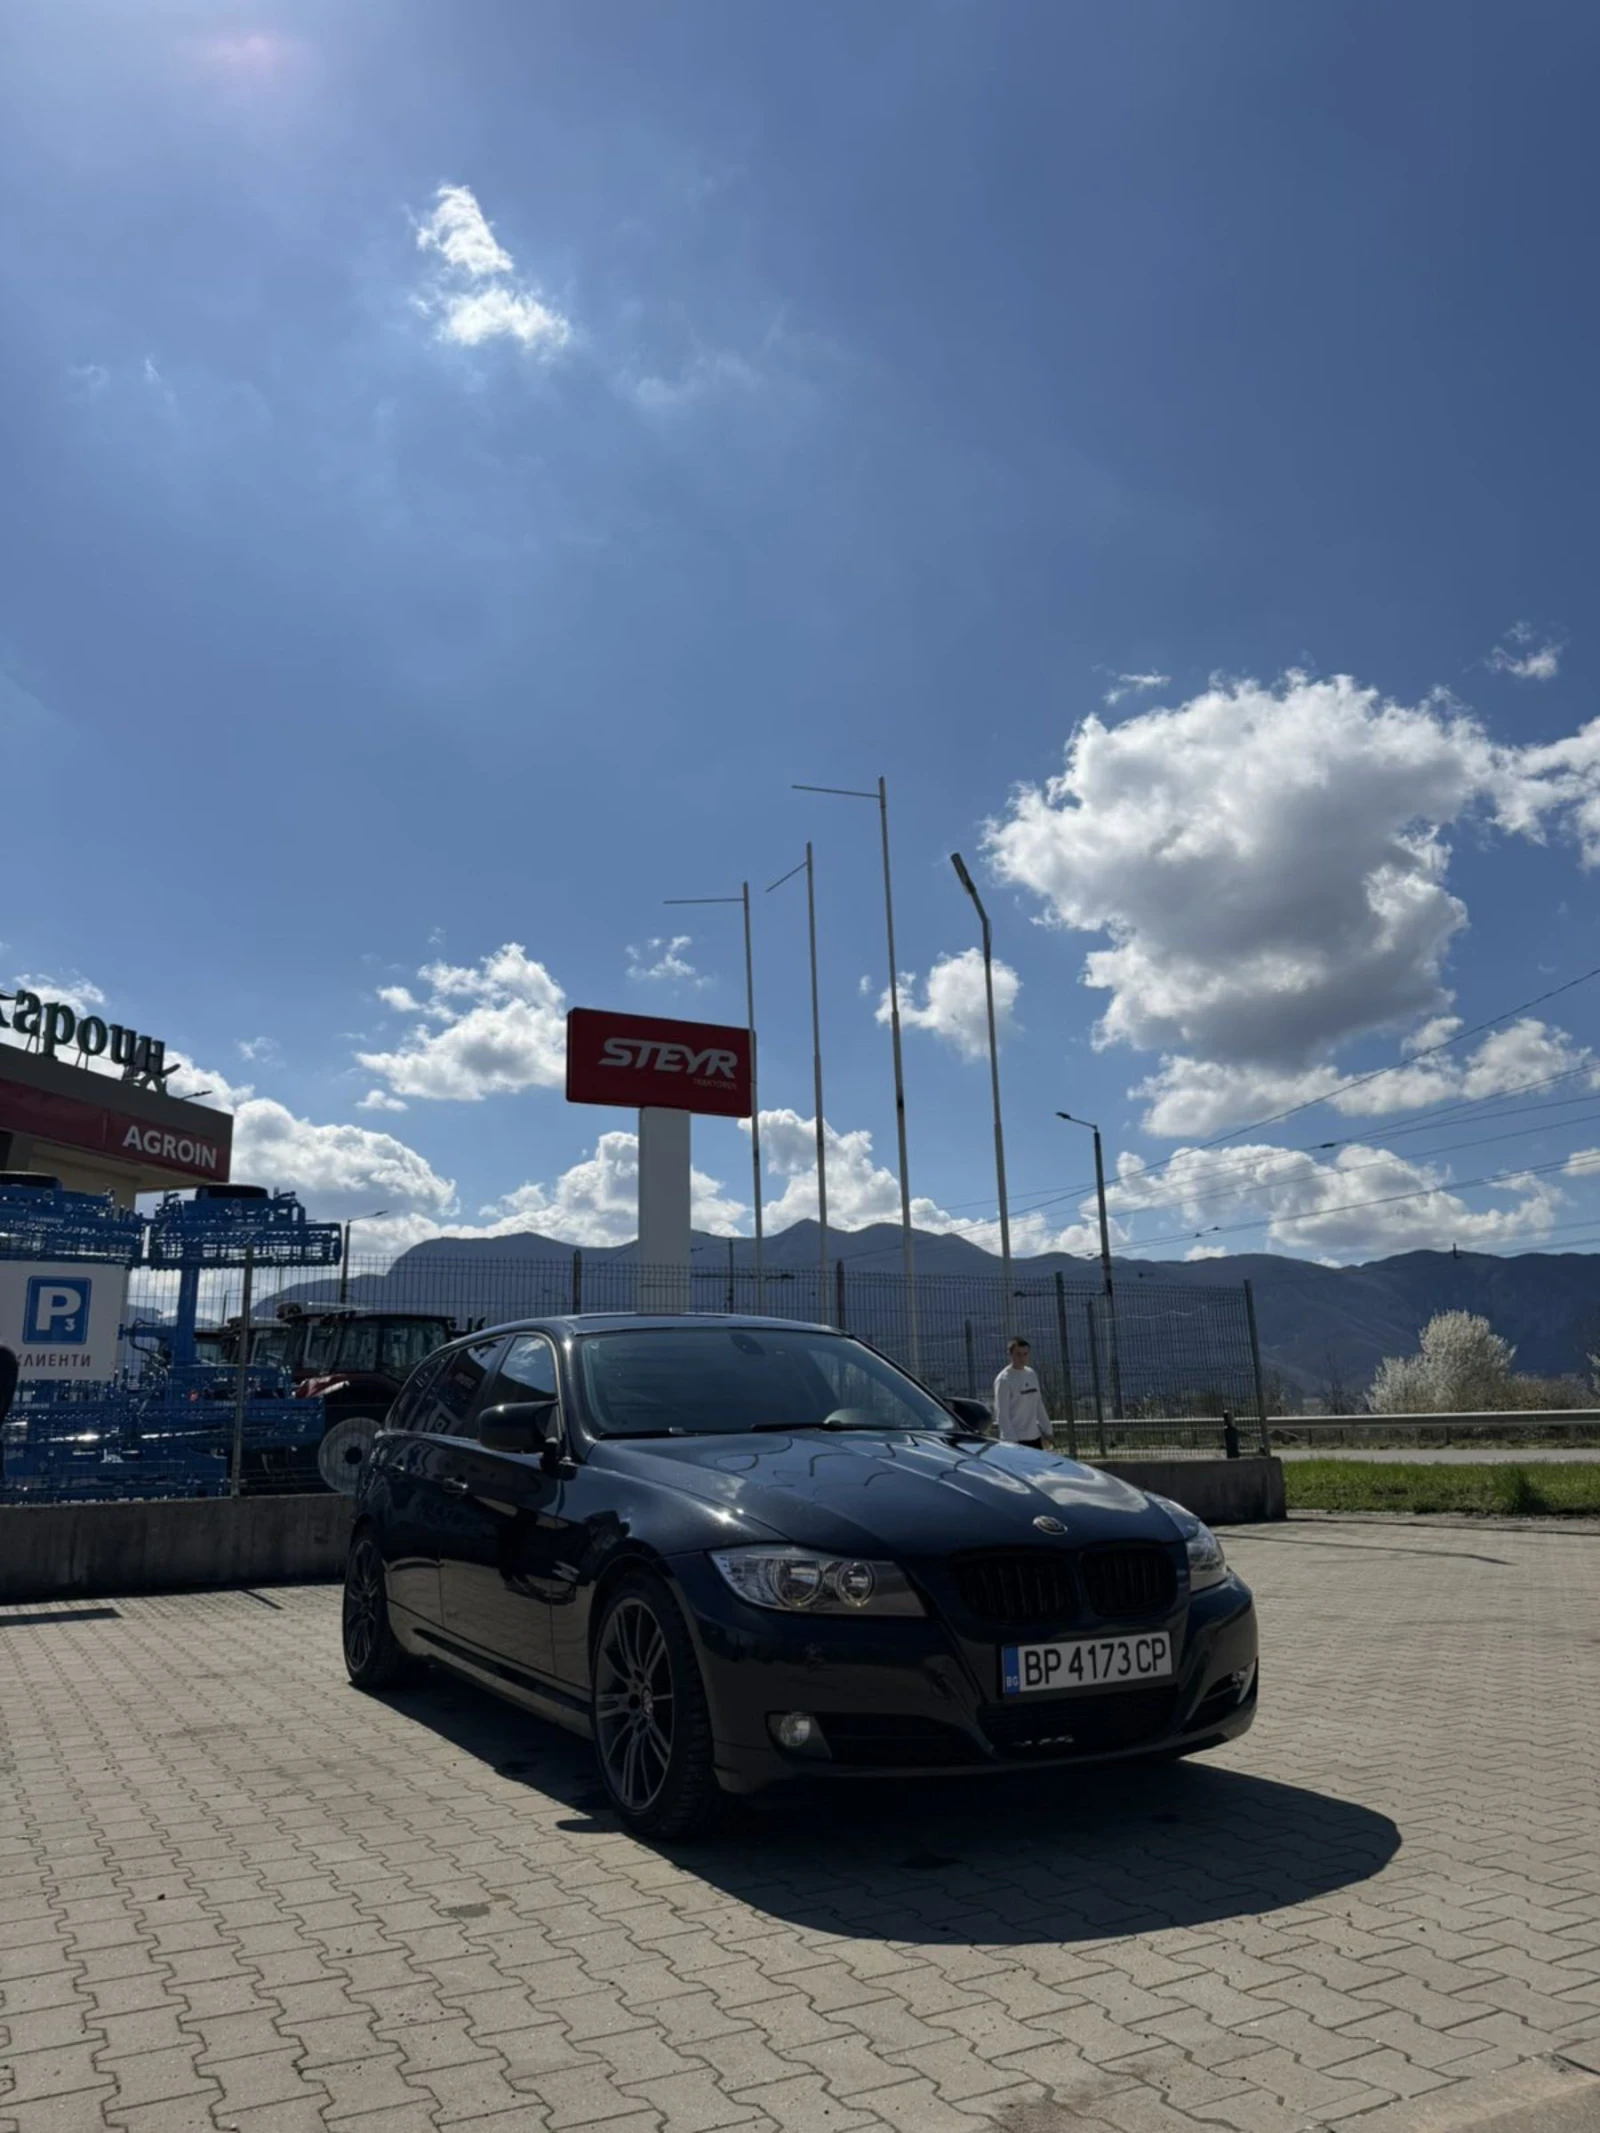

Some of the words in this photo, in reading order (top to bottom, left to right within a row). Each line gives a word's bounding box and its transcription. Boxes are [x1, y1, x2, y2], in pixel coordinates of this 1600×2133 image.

[598, 1037, 738, 1078] STEYR
[122, 1125, 217, 1168] AGROIN
[36, 1286, 81, 1331] P
[1006, 1675, 1018, 1687] BG
[1024, 1648, 1062, 1686] BP
[1068, 1642, 1131, 1681] 4173
[1136, 1638, 1167, 1673] CP
